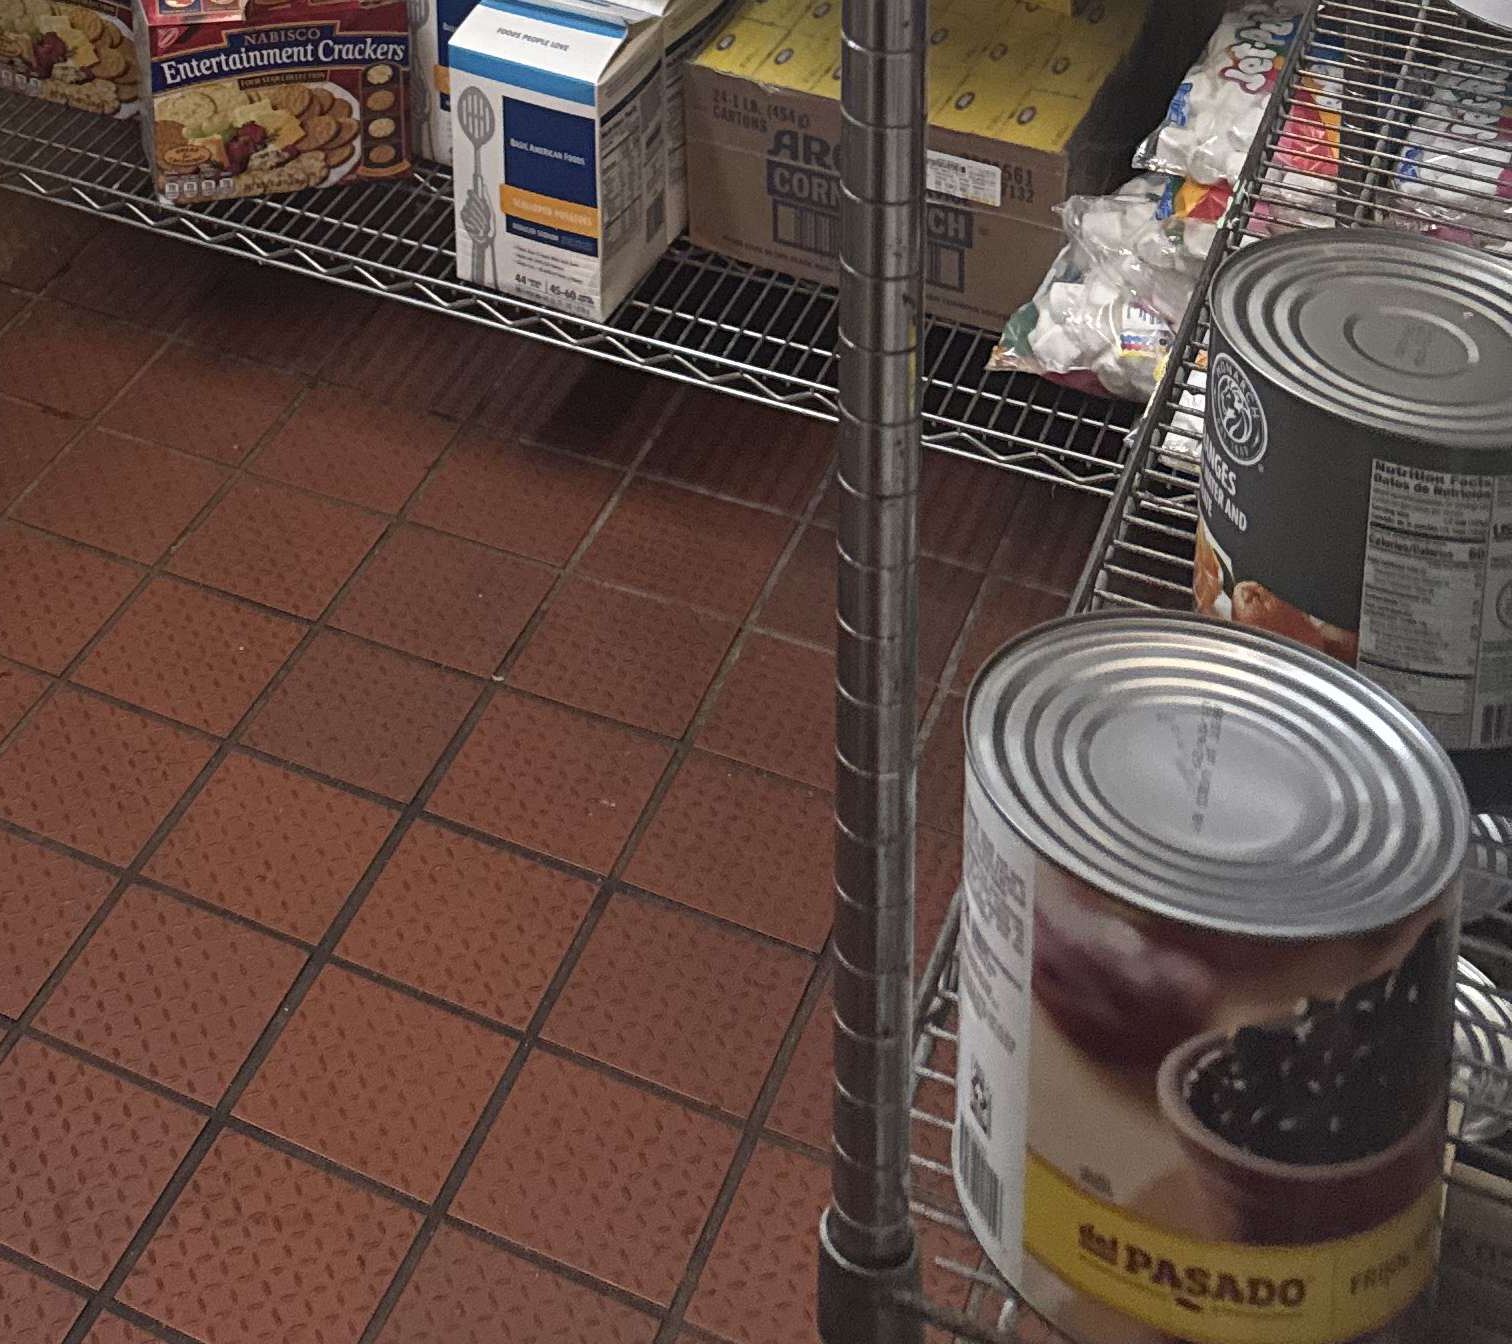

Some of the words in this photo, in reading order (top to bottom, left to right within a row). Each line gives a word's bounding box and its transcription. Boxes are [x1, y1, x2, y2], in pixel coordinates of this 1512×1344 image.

[244, 28, 321, 46] NABISCO
[522, 34, 549, 46] PEOPLE
[161, 41, 313, 84] Entertainment
[317, 38, 405, 62] Crackers
[1375, 463, 1445, 484] Nutrition
[1224, 498, 1247, 532] AND
[1124, 1243, 1307, 1307] PASADO
